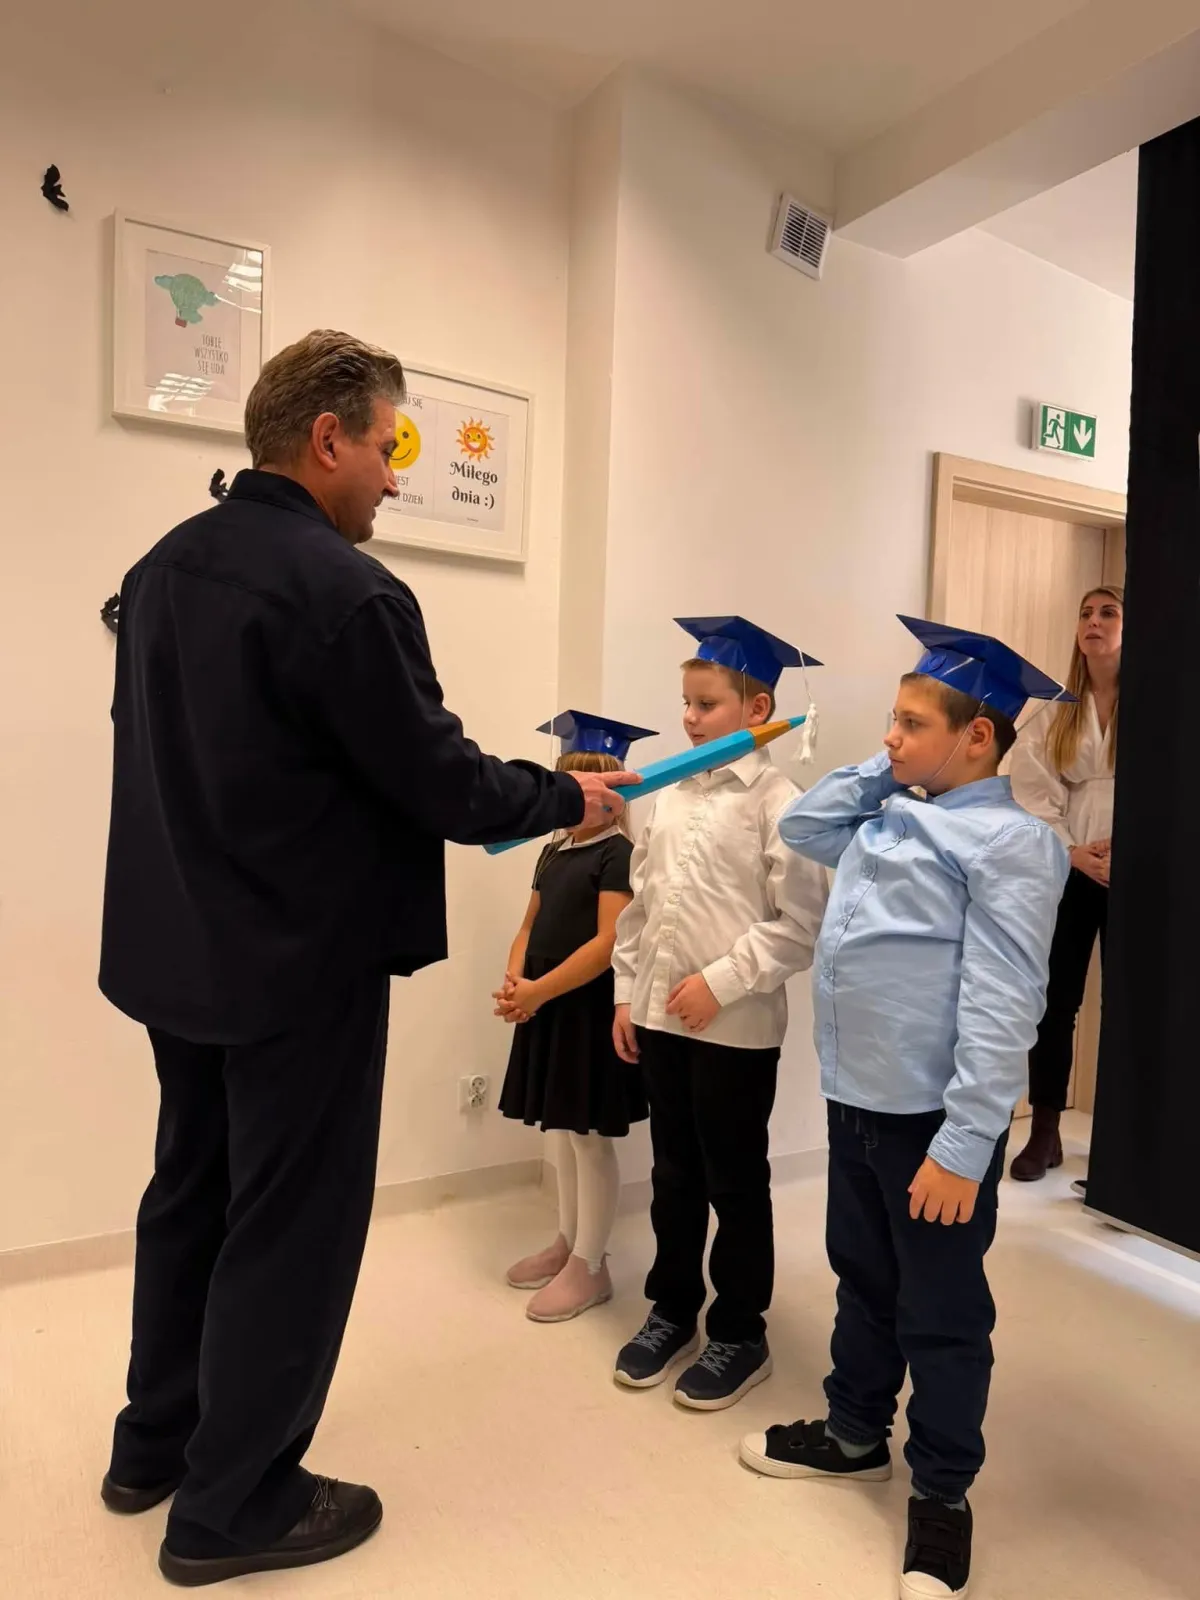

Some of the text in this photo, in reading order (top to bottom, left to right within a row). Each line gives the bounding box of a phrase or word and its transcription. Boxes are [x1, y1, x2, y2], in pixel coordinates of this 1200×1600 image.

[202, 333, 222, 349] TOBIE
[195, 347, 229, 363] WSZYSTKO
[210, 361, 225, 375] UDA
[402, 492, 424, 505] DZIEŃ
[451, 485, 480, 505] dnia
